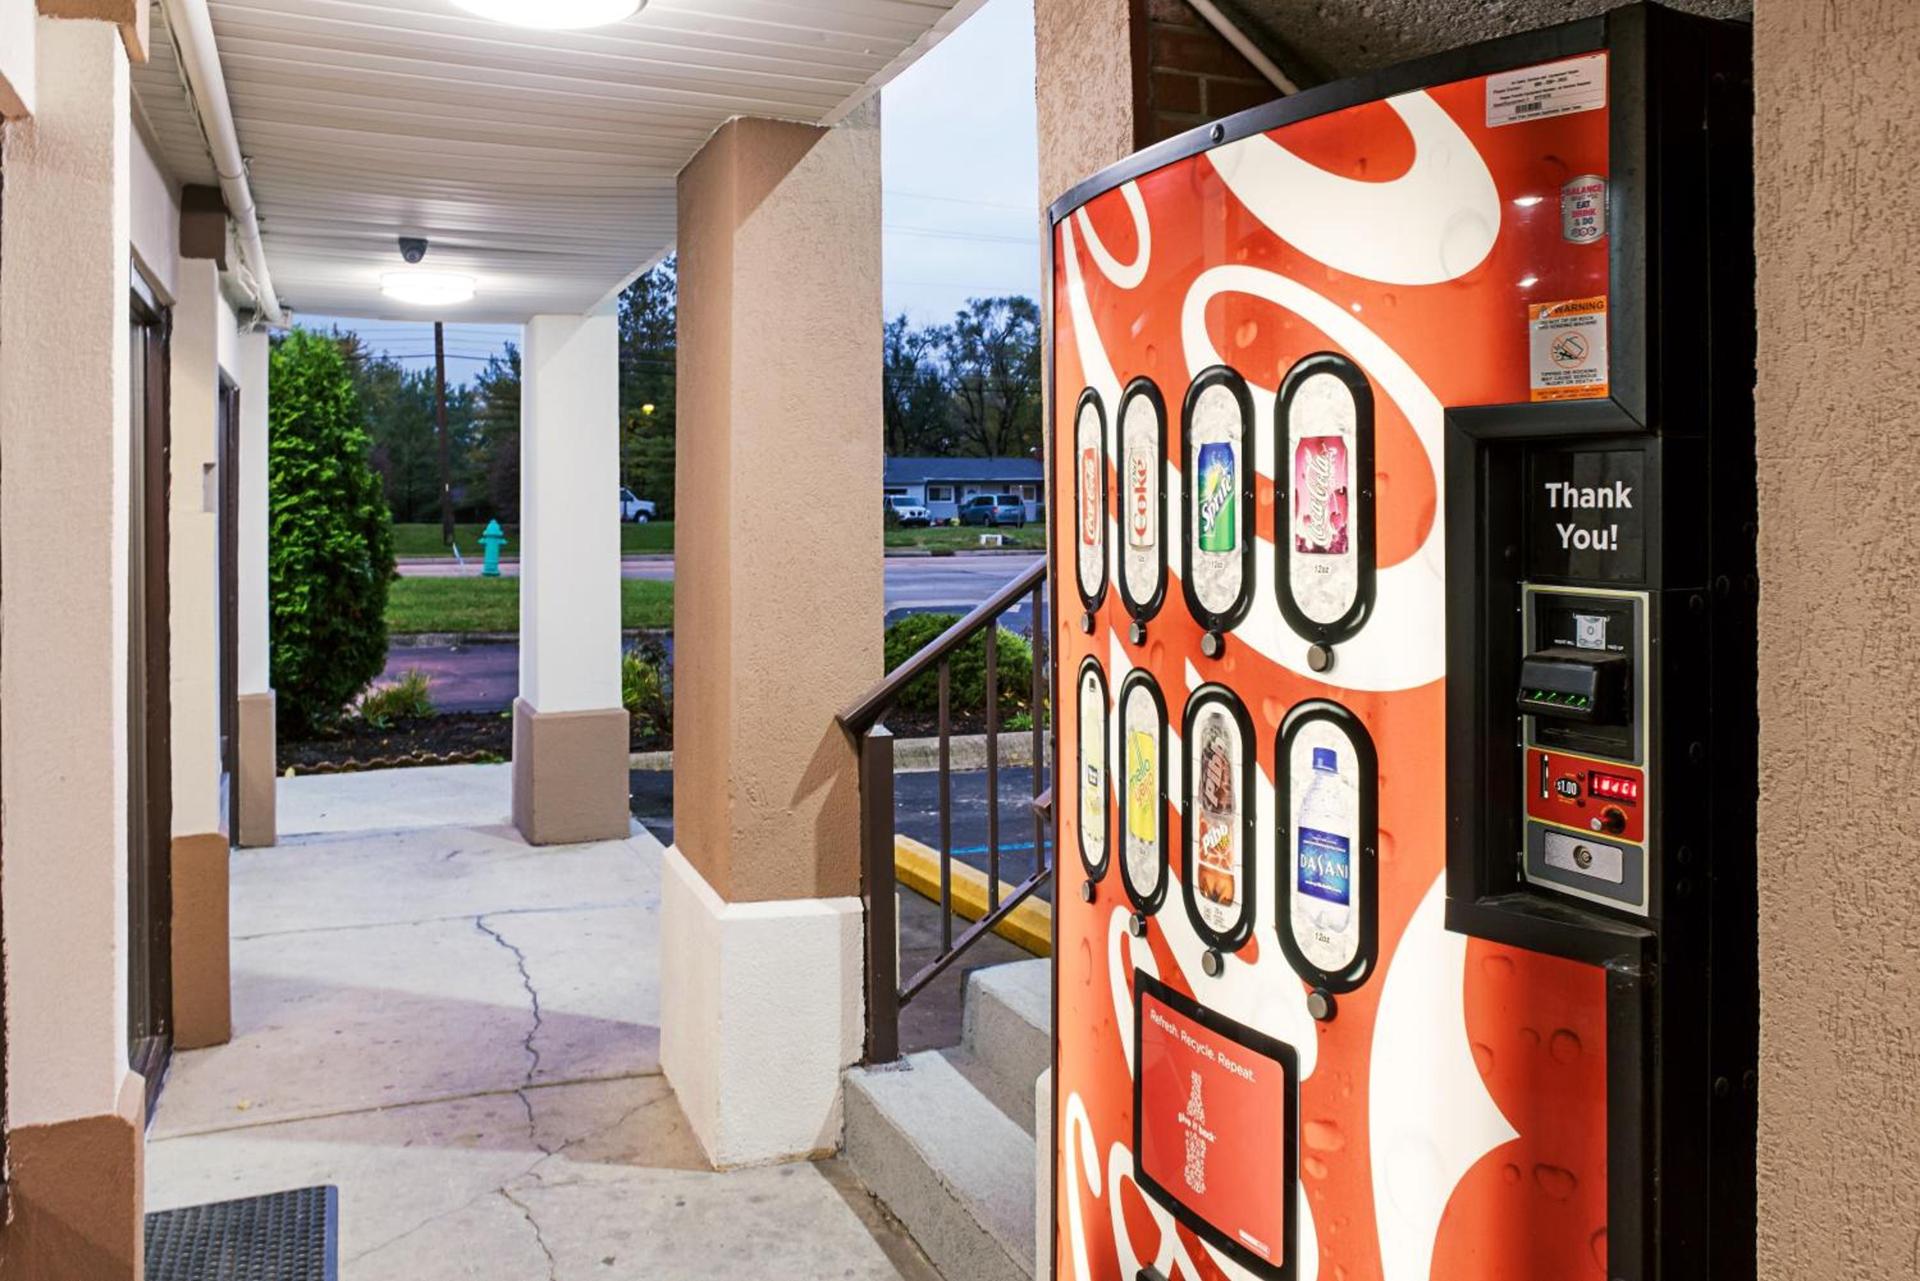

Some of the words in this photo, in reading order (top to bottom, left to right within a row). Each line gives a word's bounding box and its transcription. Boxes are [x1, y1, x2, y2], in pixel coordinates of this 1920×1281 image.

[1577, 200, 1590, 209] EAT
[1554, 301, 1604, 314] WARNING
[1134, 459, 1147, 537] Coke
[1544, 481, 1632, 508] Thank
[1556, 523, 1618, 550] You!
[1557, 779, 1577, 797] $1.00
[1300, 854, 1348, 879] DASANI
[1150, 1008, 1180, 1039] Refresh.
[1180, 1030, 1216, 1061] Recycle.
[1218, 1052, 1256, 1083] Repeat.
